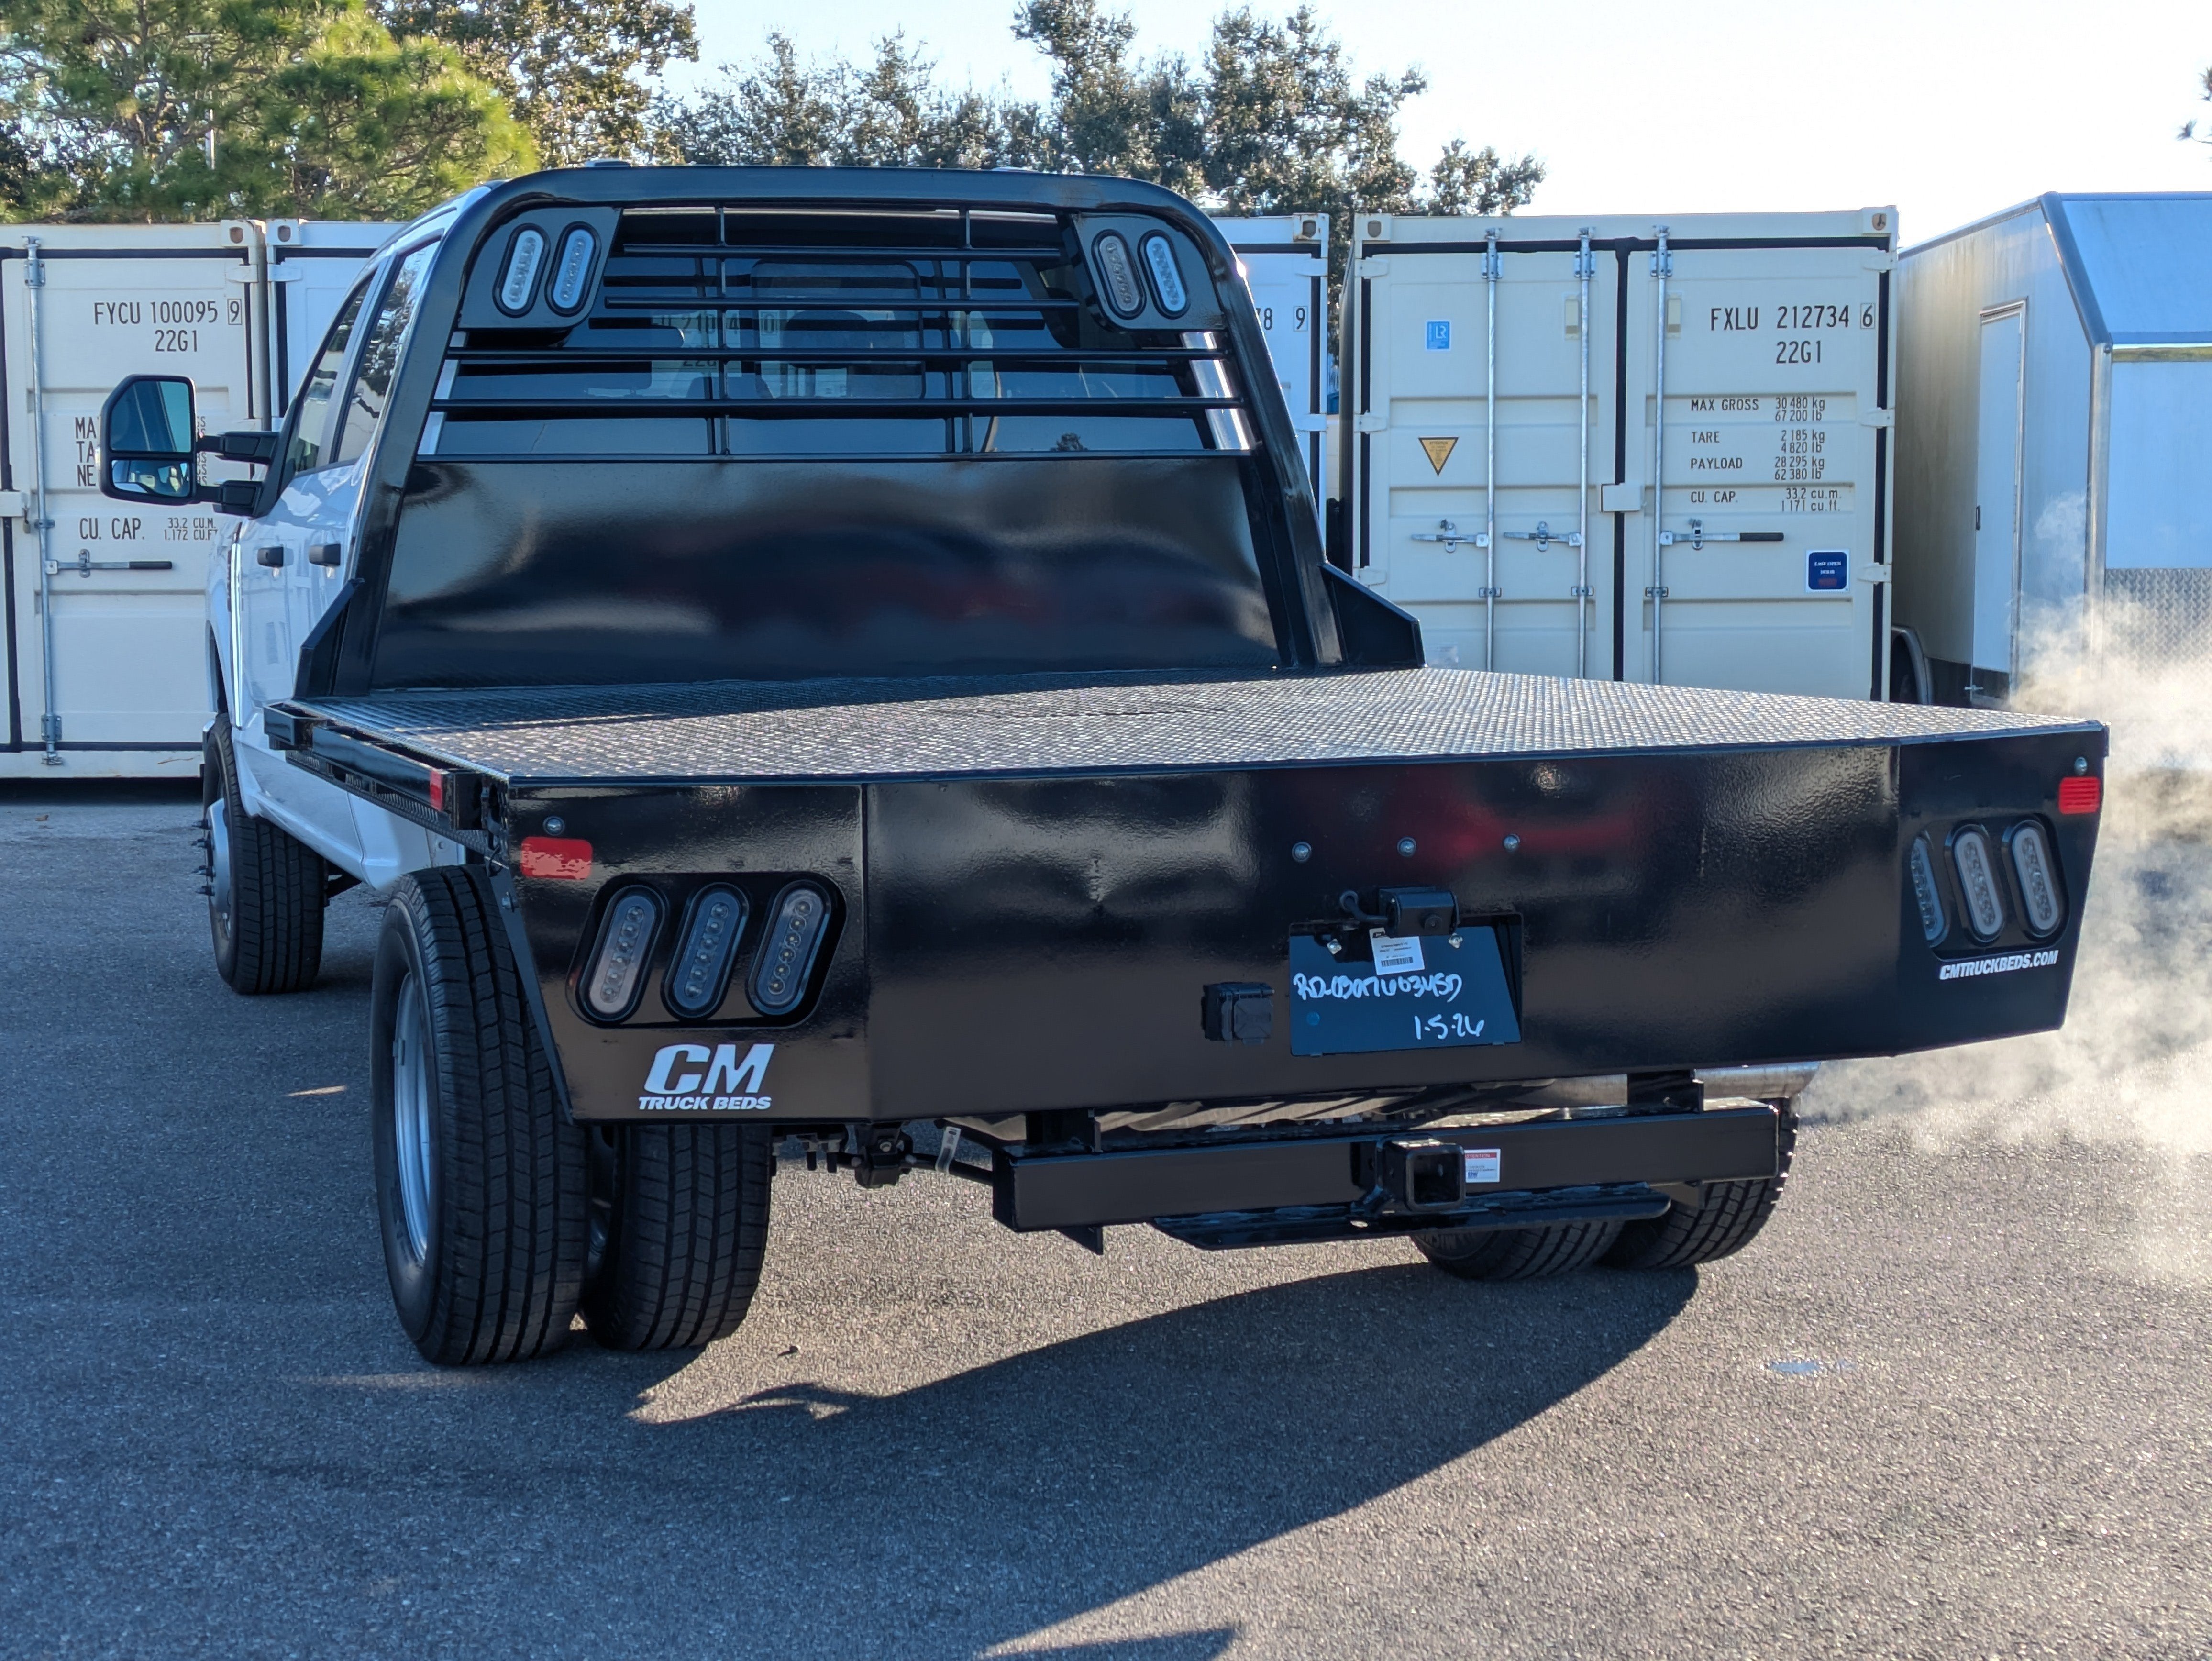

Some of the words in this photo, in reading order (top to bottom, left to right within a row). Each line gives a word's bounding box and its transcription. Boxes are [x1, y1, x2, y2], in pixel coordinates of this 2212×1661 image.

[94, 302, 141, 325] FYCU
[150, 301, 218, 324] 100095
[230, 301, 240, 323] 9
[1296, 307, 1305, 330] 9
[1711, 307, 1759, 331] FXLU
[1777, 305, 1849, 328] 212734
[1862, 305, 1873, 327] 6
[155, 330, 197, 352] 22G1
[1776, 340, 1821, 364] 22G1
[1691, 398, 1715, 411] MAX
[1721, 398, 1759, 411] GROSS
[1775, 397, 1787, 409] 30
[1790, 397, 1808, 409] 480
[1812, 396, 1825, 411] kg
[1775, 410, 1787, 421] 67
[1790, 410, 1808, 421] 200
[1812, 409, 1822, 421] lb
[75, 417, 99, 439] MA
[1692, 431, 1720, 443] TARE
[1812, 429, 1825, 443] kg
[1812, 441, 1822, 453] lb
[1690, 457, 1743, 469] PAYLOAD
[1775, 456, 1787, 468] 28
[1789, 456, 1807, 468] 295
[1812, 455, 1825, 470] kg
[1774, 468, 1787, 480] 62
[1789, 468, 1807, 480] 380
[1811, 468, 1822, 480] lb
[1691, 490, 1708, 503] CU.
[1714, 490, 1738, 503] CAP.
[1811, 489, 1842, 499] cu.m.
[1811, 500, 1840, 512] cu.ft.
[79, 517, 102, 540] CU.
[111, 517, 145, 540] CAP.
[167, 517, 188, 529] 33.2
[193, 517, 216, 529] CU.M.
[164, 529, 188, 541] 1.172
[1939, 950, 2059, 980] CMTRUCKBEDS.COM
[644, 1043, 775, 1095] CM
[638, 1096, 710, 1110] TRUCK
[712, 1096, 772, 1110] BEDS
